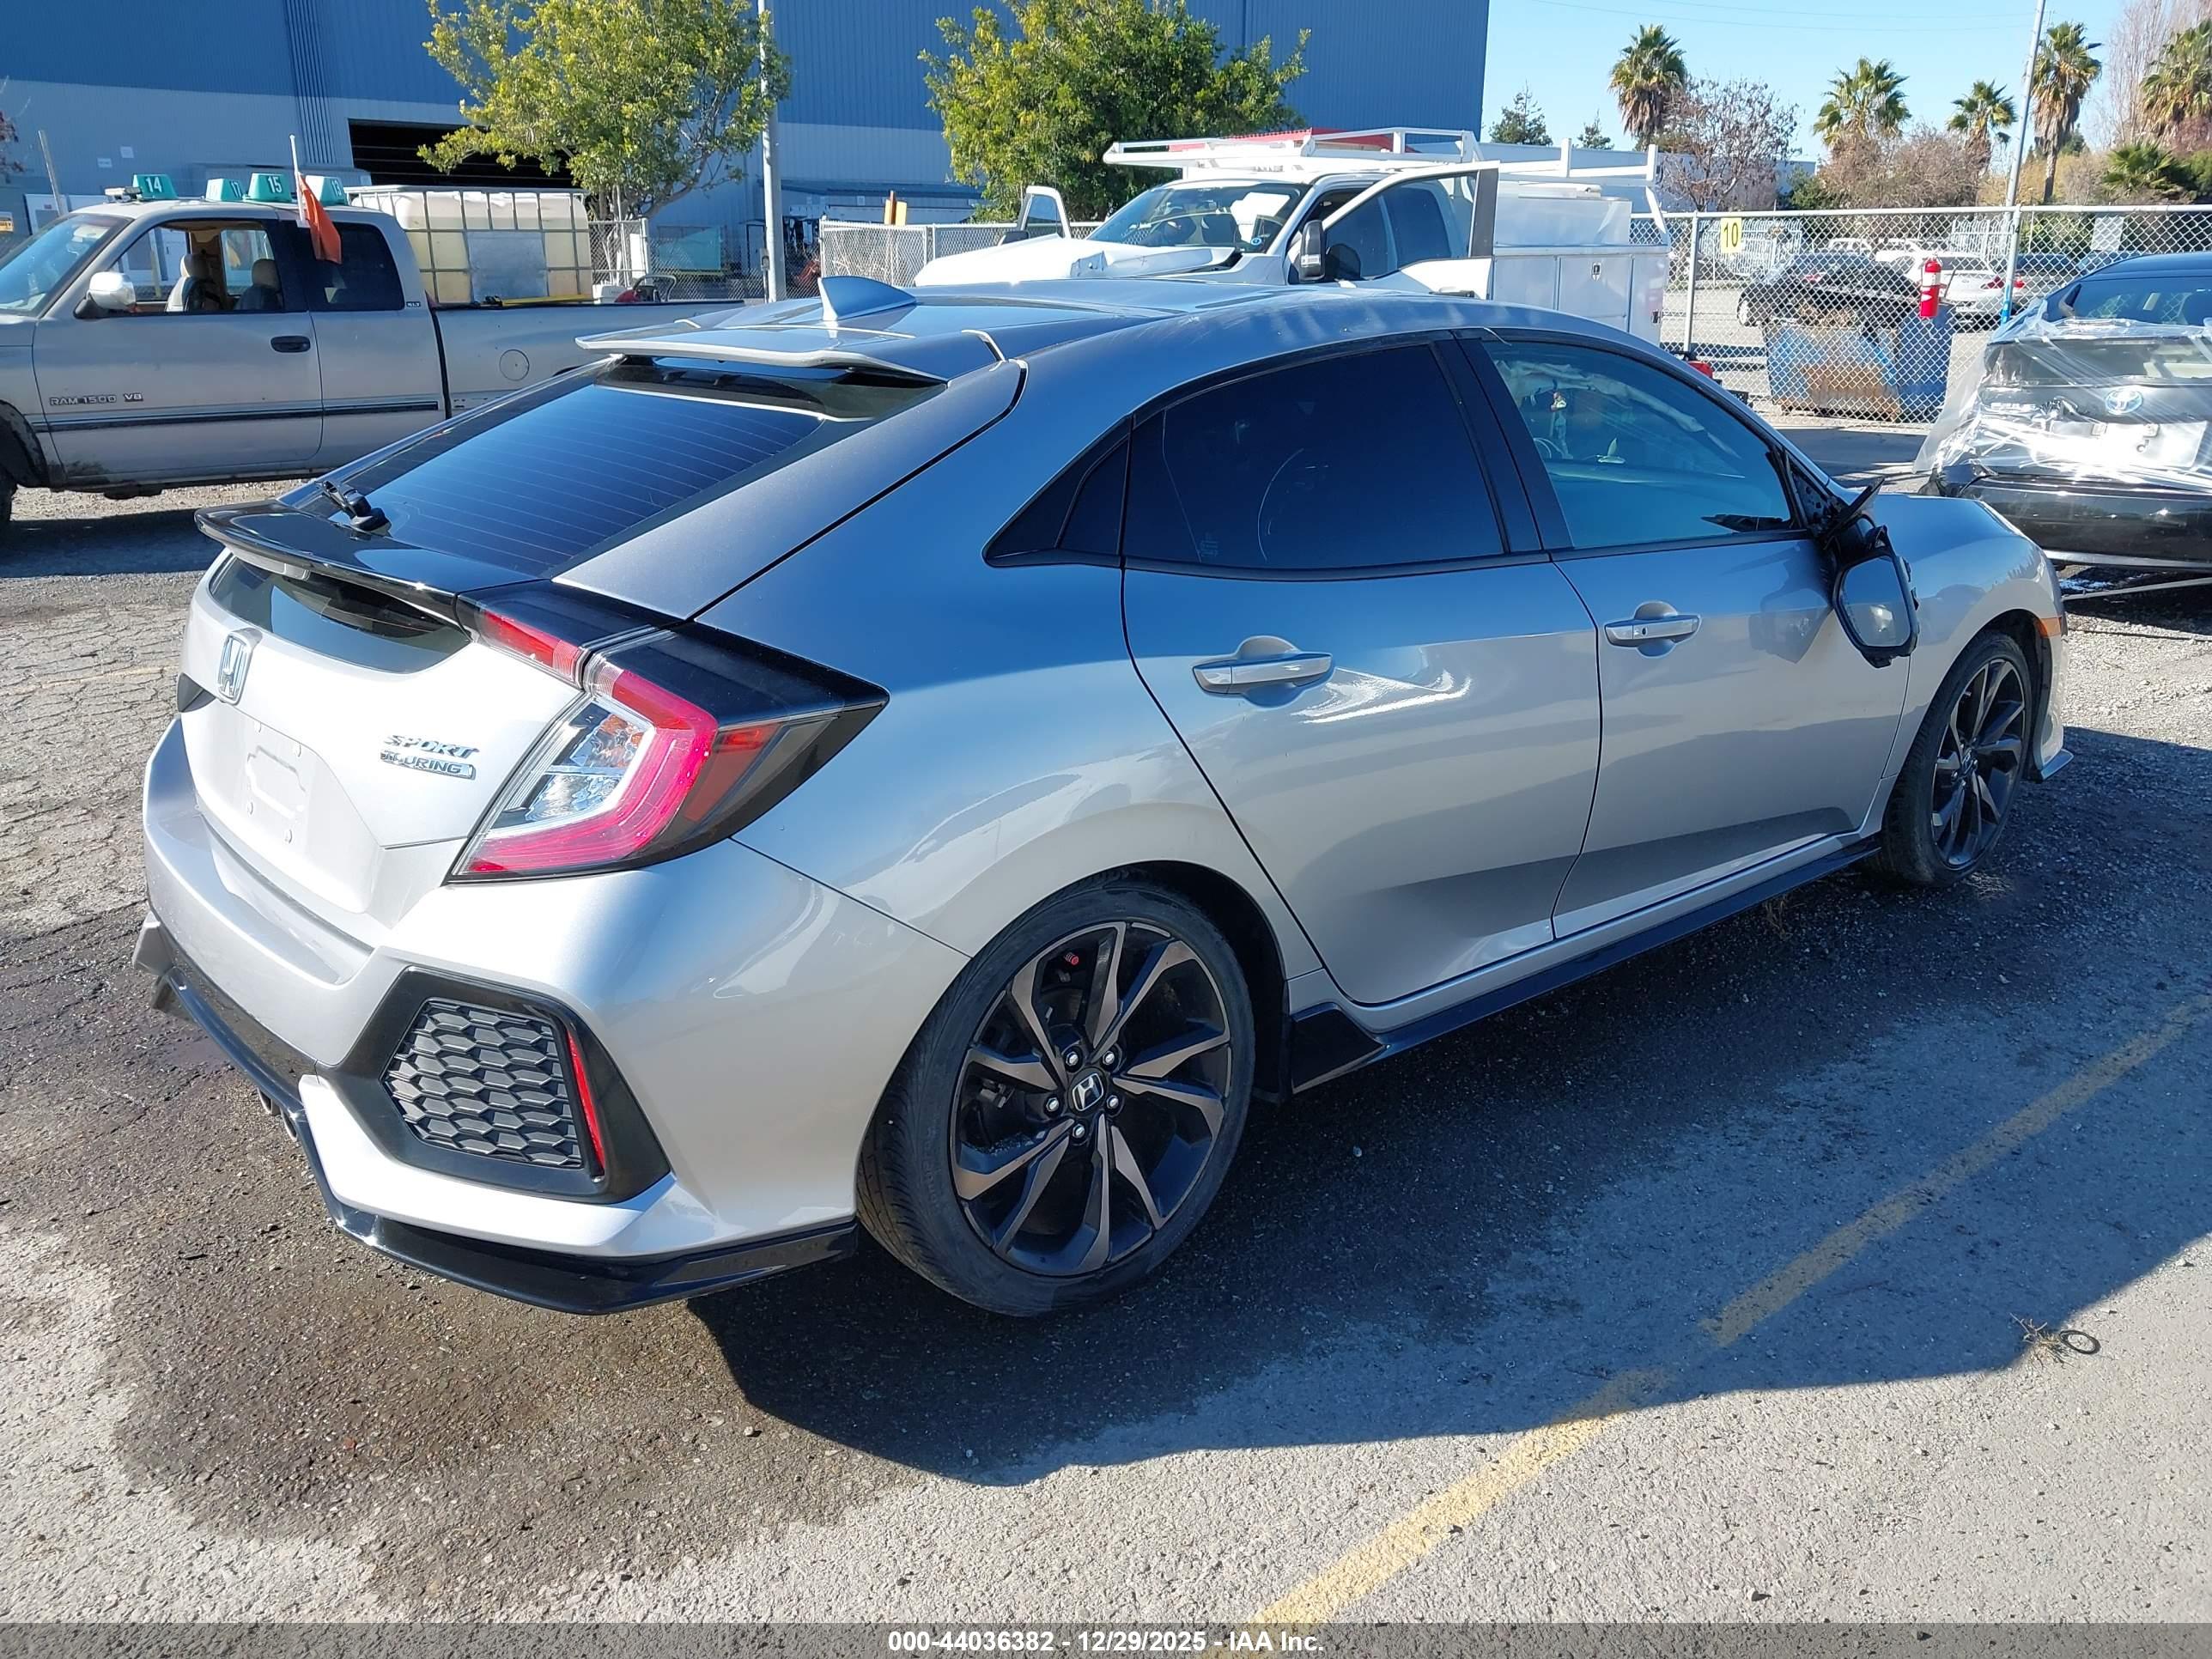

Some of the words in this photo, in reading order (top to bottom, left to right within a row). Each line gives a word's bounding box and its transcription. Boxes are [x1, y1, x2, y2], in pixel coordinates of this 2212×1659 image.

[145, 176, 163, 193] 14
[229, 180, 242, 198] 17
[267, 175, 283, 194] 15
[331, 179, 343, 197] 13
[1723, 222, 1739, 248] 10
[51, 397, 79, 406] RAM
[82, 394, 118, 404] 1500
[123, 393, 144, 402] V8
[384, 735, 480, 759] SPORT
[380, 750, 463, 775] TOURING
